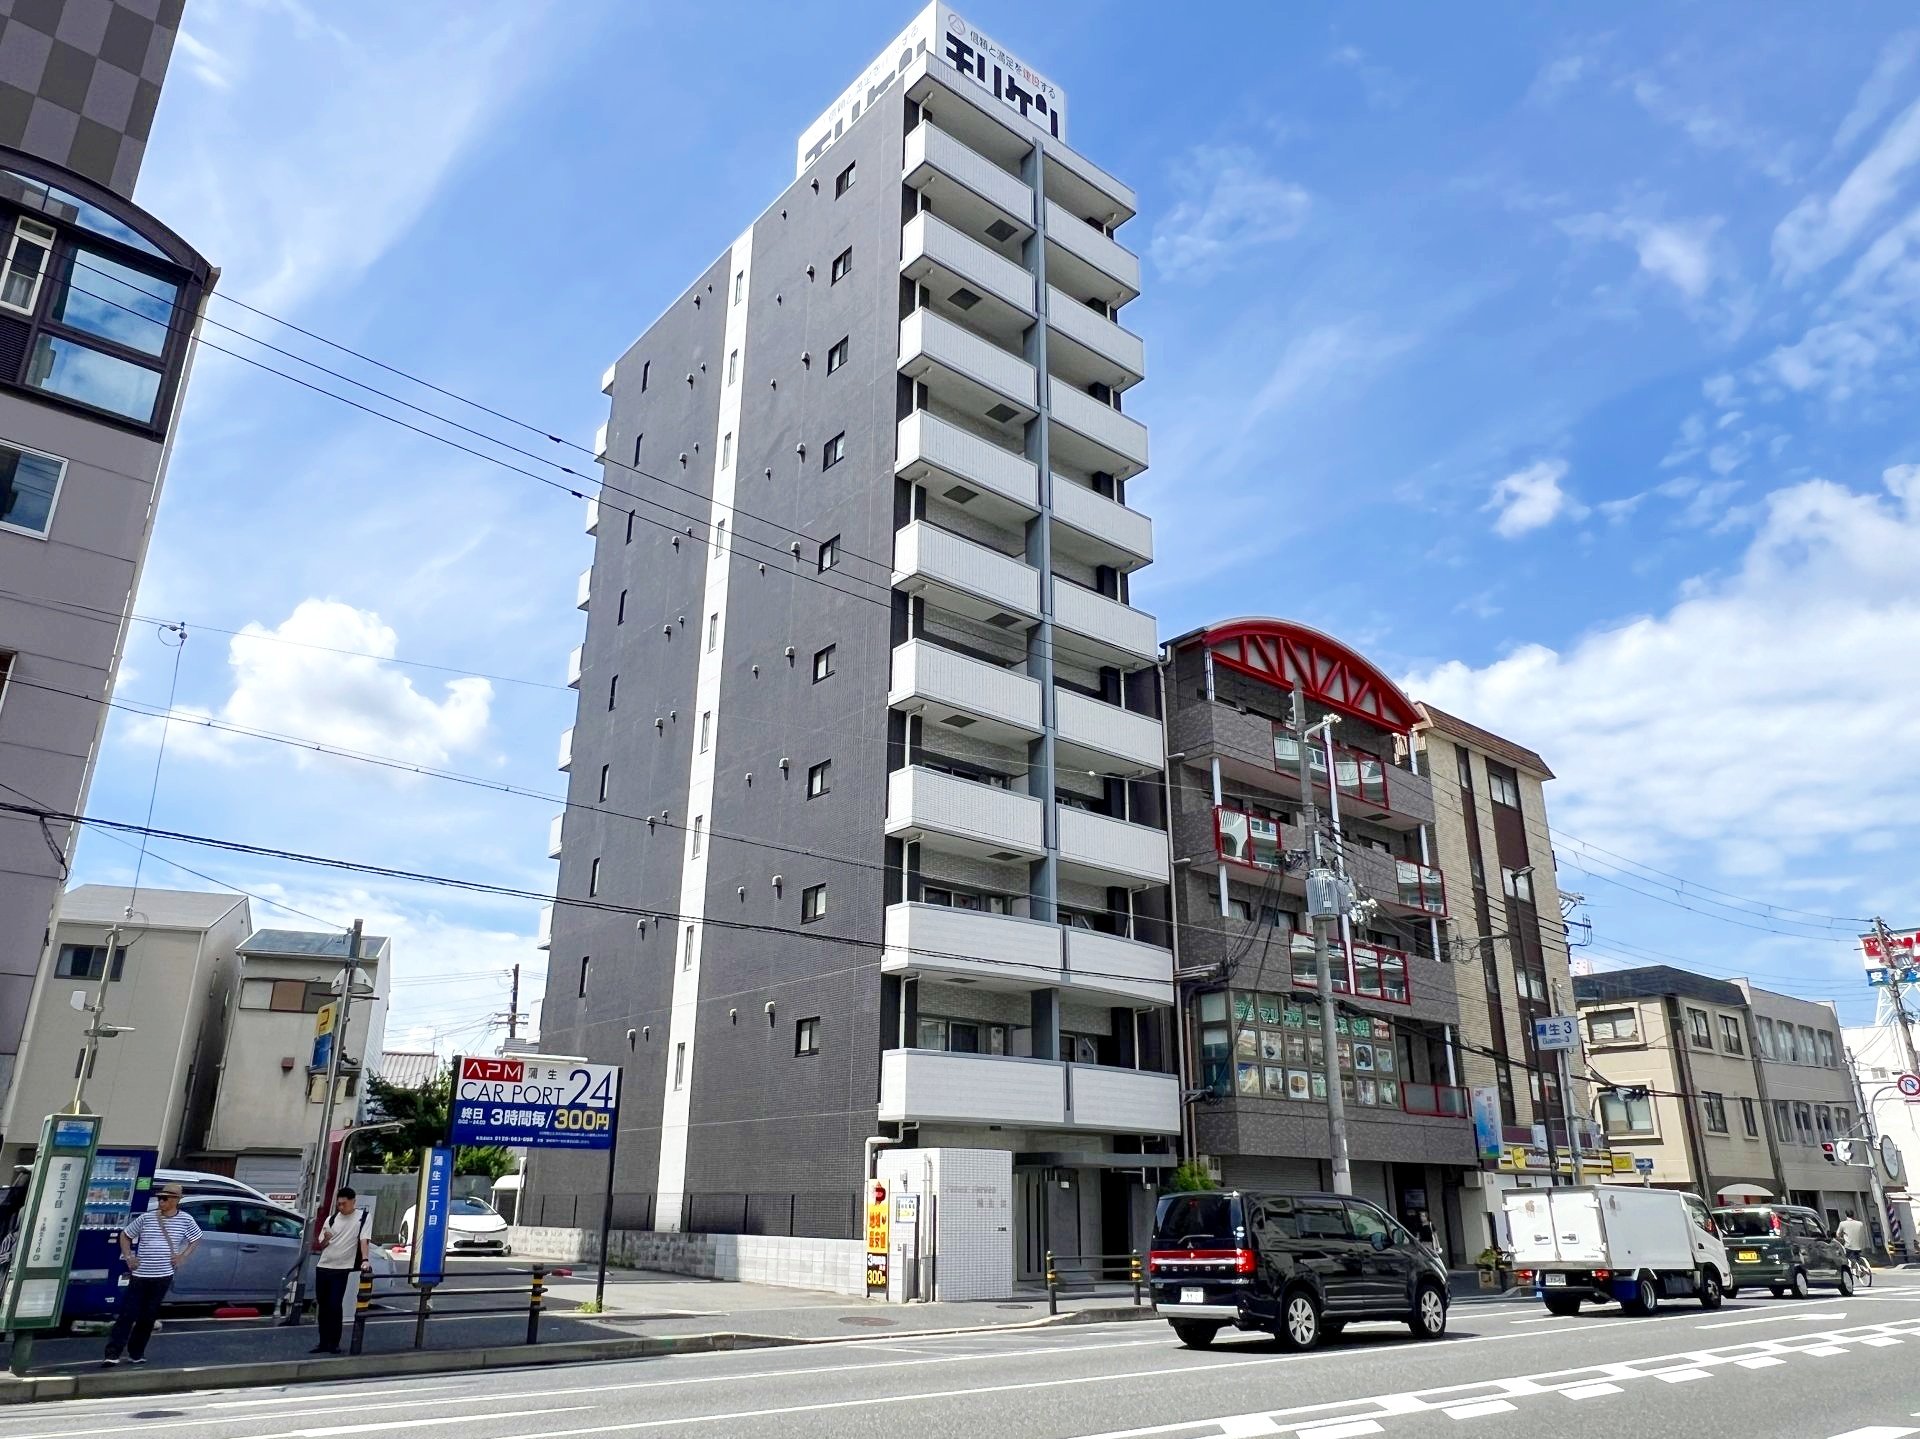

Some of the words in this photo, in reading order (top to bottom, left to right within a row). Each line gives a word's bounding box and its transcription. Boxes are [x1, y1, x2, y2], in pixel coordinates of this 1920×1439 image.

[946, 31, 1059, 139] モリケン
[466, 1061, 522, 1080] APM
[460, 1082, 504, 1103] CAR
[511, 1085, 565, 1106] PORT
[569, 1069, 613, 1108] 24
[460, 1107, 484, 1120] 終日
